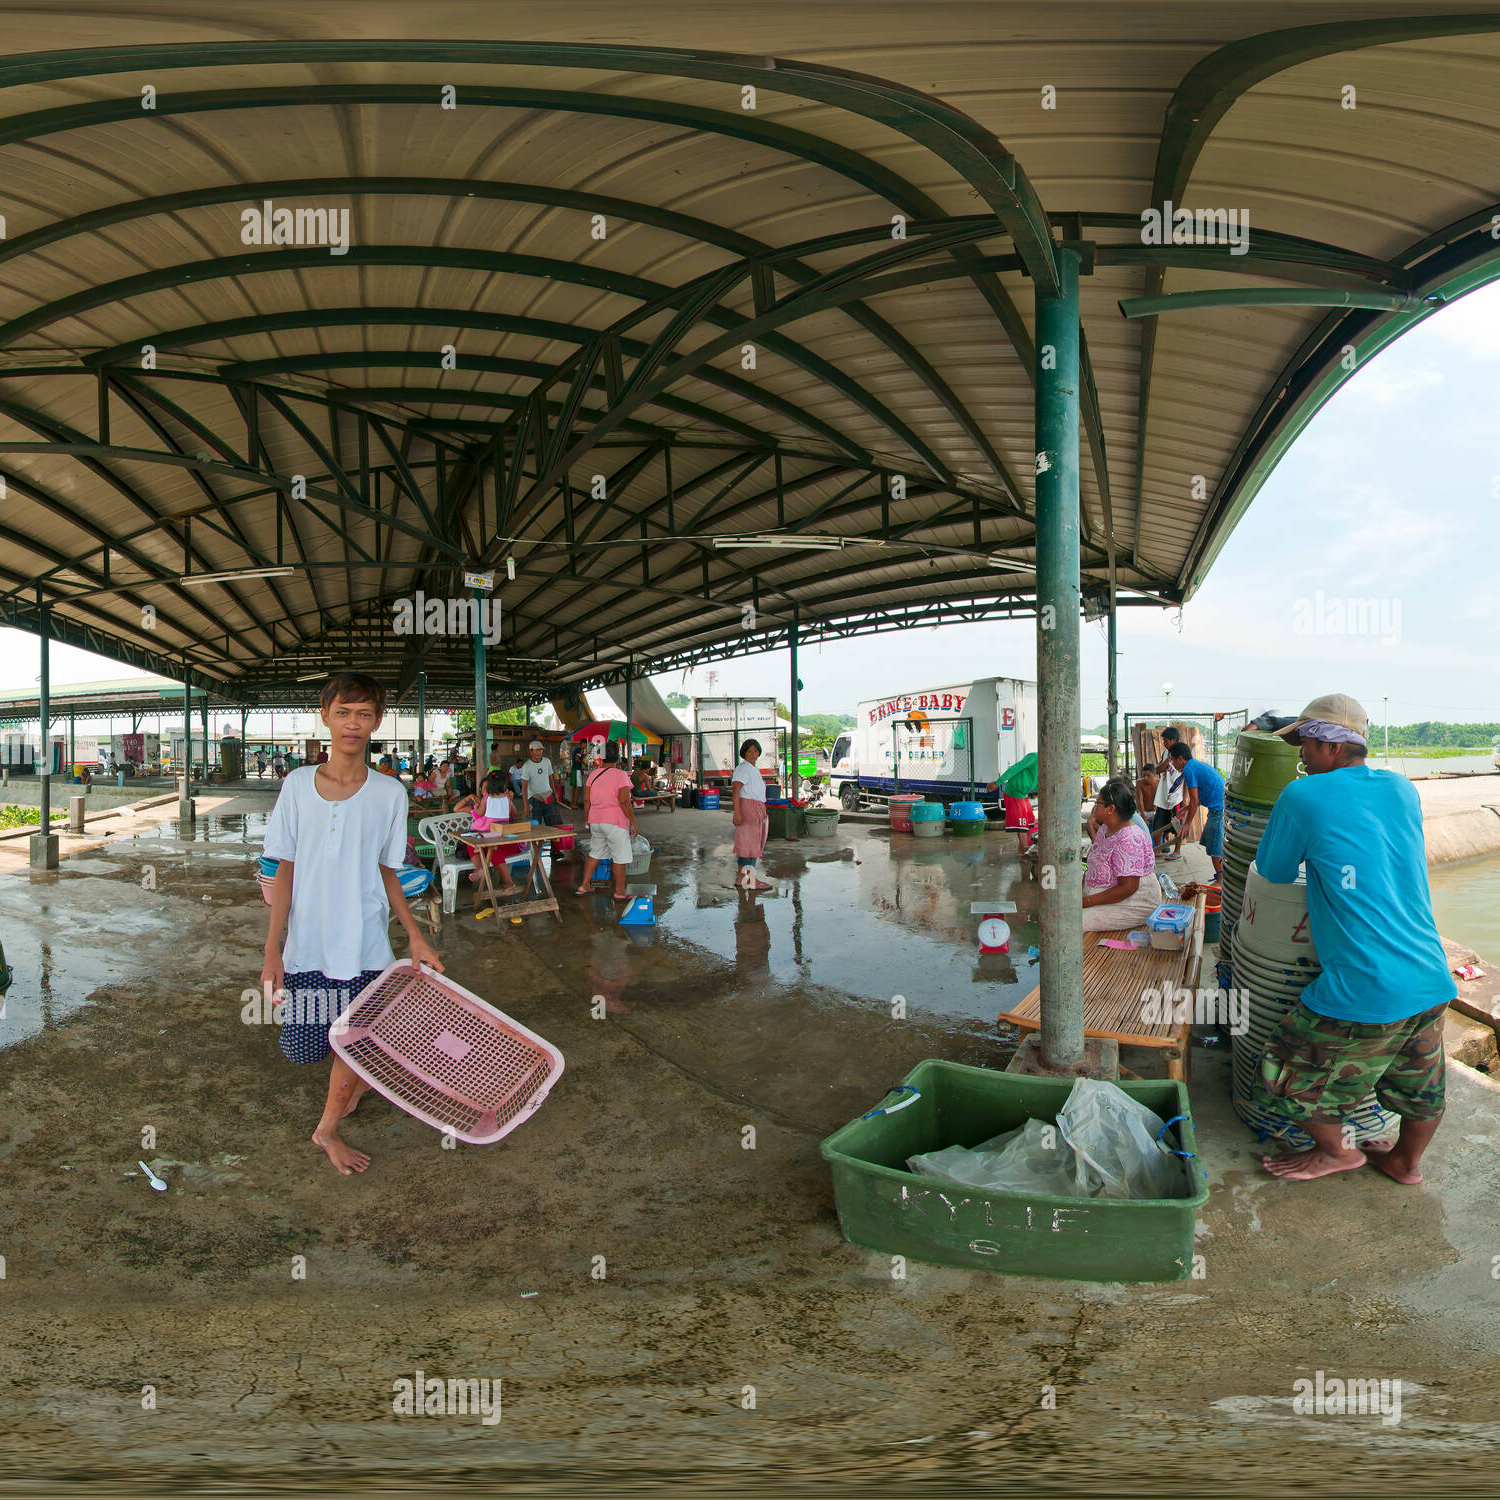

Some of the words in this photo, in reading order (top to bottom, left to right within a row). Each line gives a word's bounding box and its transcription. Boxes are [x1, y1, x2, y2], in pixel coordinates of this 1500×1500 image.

[868, 696, 912, 725] ERNIE
[918, 693, 968, 711] BABY
[909, 750, 945, 761] DEALER
[1018, 817, 1027, 826] 18
